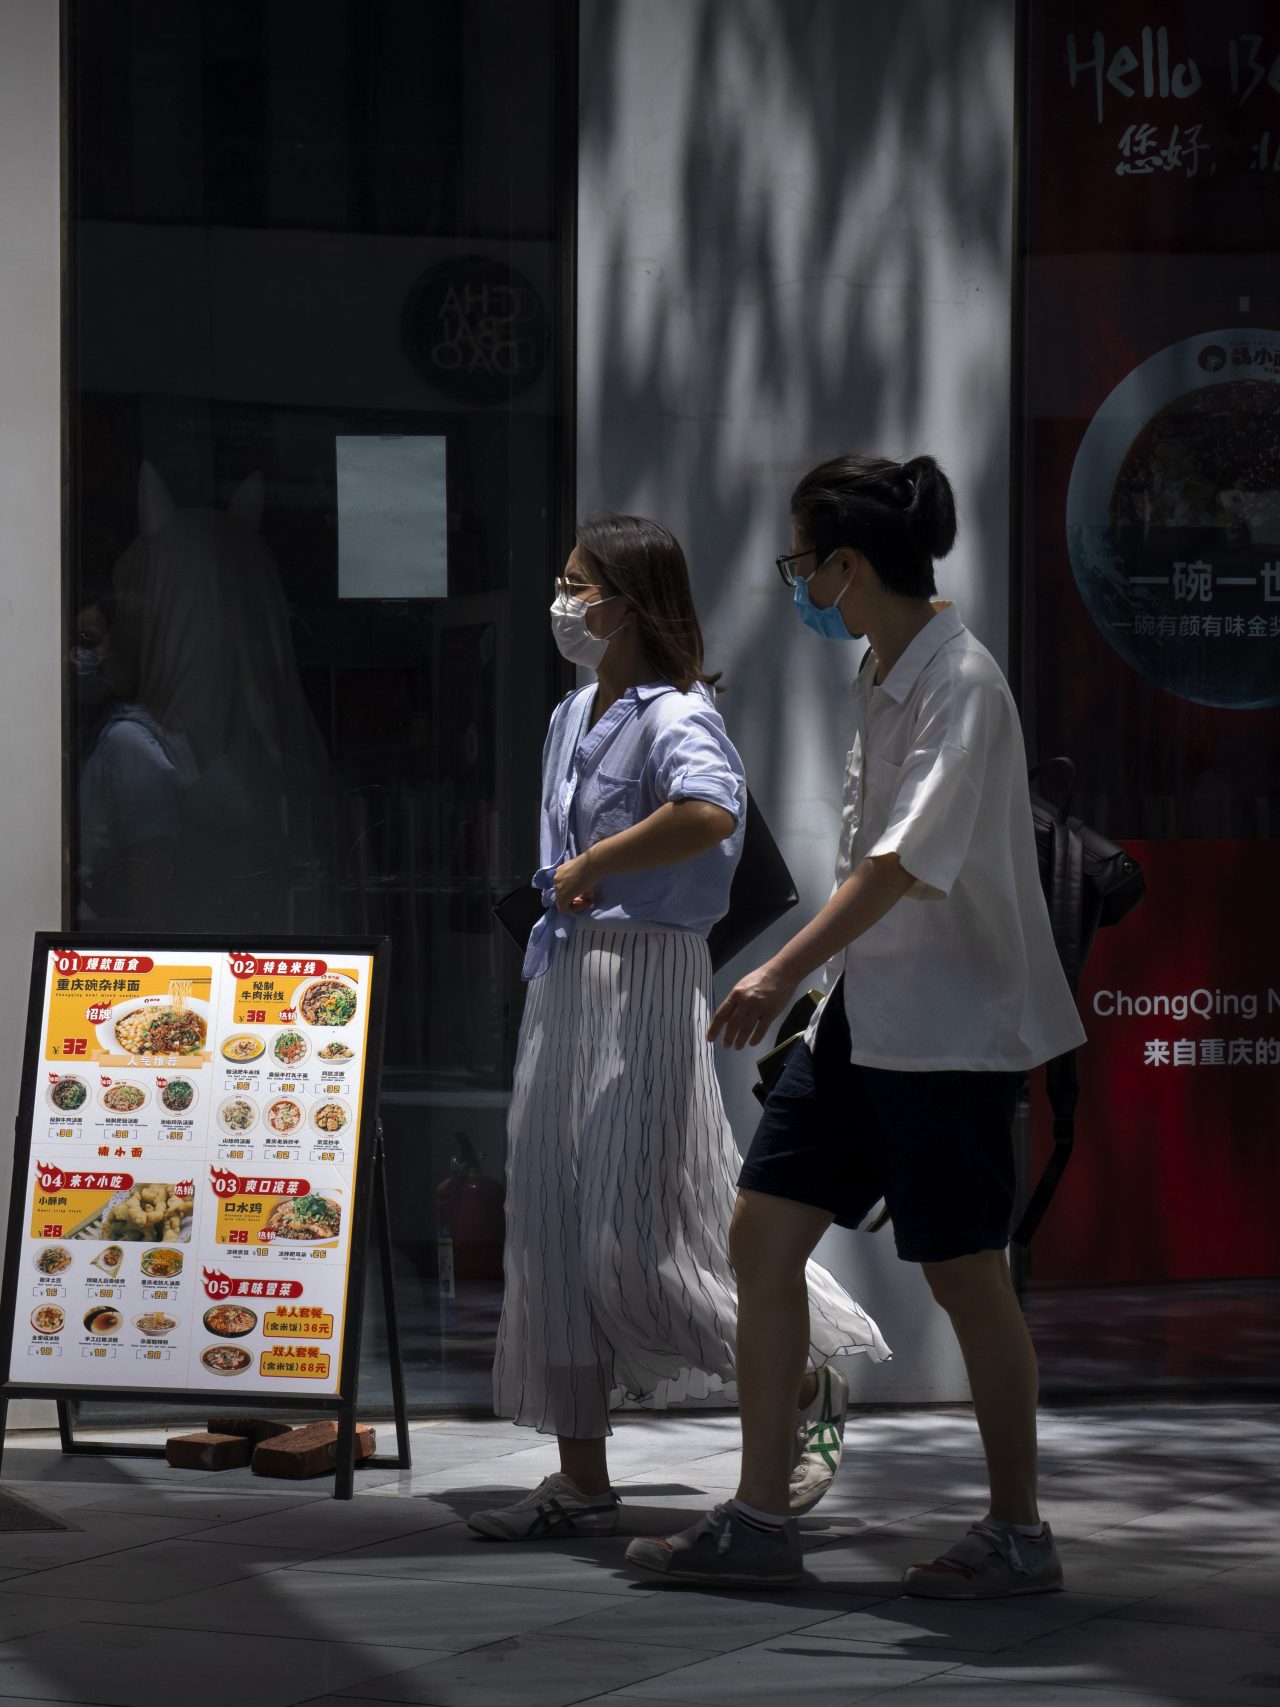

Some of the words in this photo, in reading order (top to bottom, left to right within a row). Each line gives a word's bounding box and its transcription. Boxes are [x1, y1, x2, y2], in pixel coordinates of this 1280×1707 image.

[1066, 25, 1202, 124] Hello
[59, 958, 79, 971] 01
[86, 958, 140, 971] 爆款面食
[233, 961, 255, 974] 02
[263, 961, 317, 974] 特色米线
[56, 978, 141, 992] 重庆碗杂拌面
[252, 981, 274, 991] 秘制
[241, 991, 285, 1001] 牛肉米线
[1093, 988, 1258, 1021] ChongQing
[85, 1008, 113, 1021] 招牌
[1143, 1038, 1280, 1067] 来自重庆的
[127, 1056, 179, 1067] 人气推荐
[41, 1174, 62, 1187] 04
[70, 1175, 124, 1188] 来个小吃
[215, 1179, 237, 1193] 03
[245, 1180, 300, 1194] 爽口凉菜
[173, 1185, 194, 1196] 热销
[38, 1197, 67, 1206] 小酥肉
[224, 1202, 263, 1214] 口水鸡
[208, 1281, 229, 1294] 05
[237, 1281, 293, 1296] 美味冒菜
[276, 1306, 324, 1319] 单人套餐
[272, 1346, 320, 1358] 双人套餐
